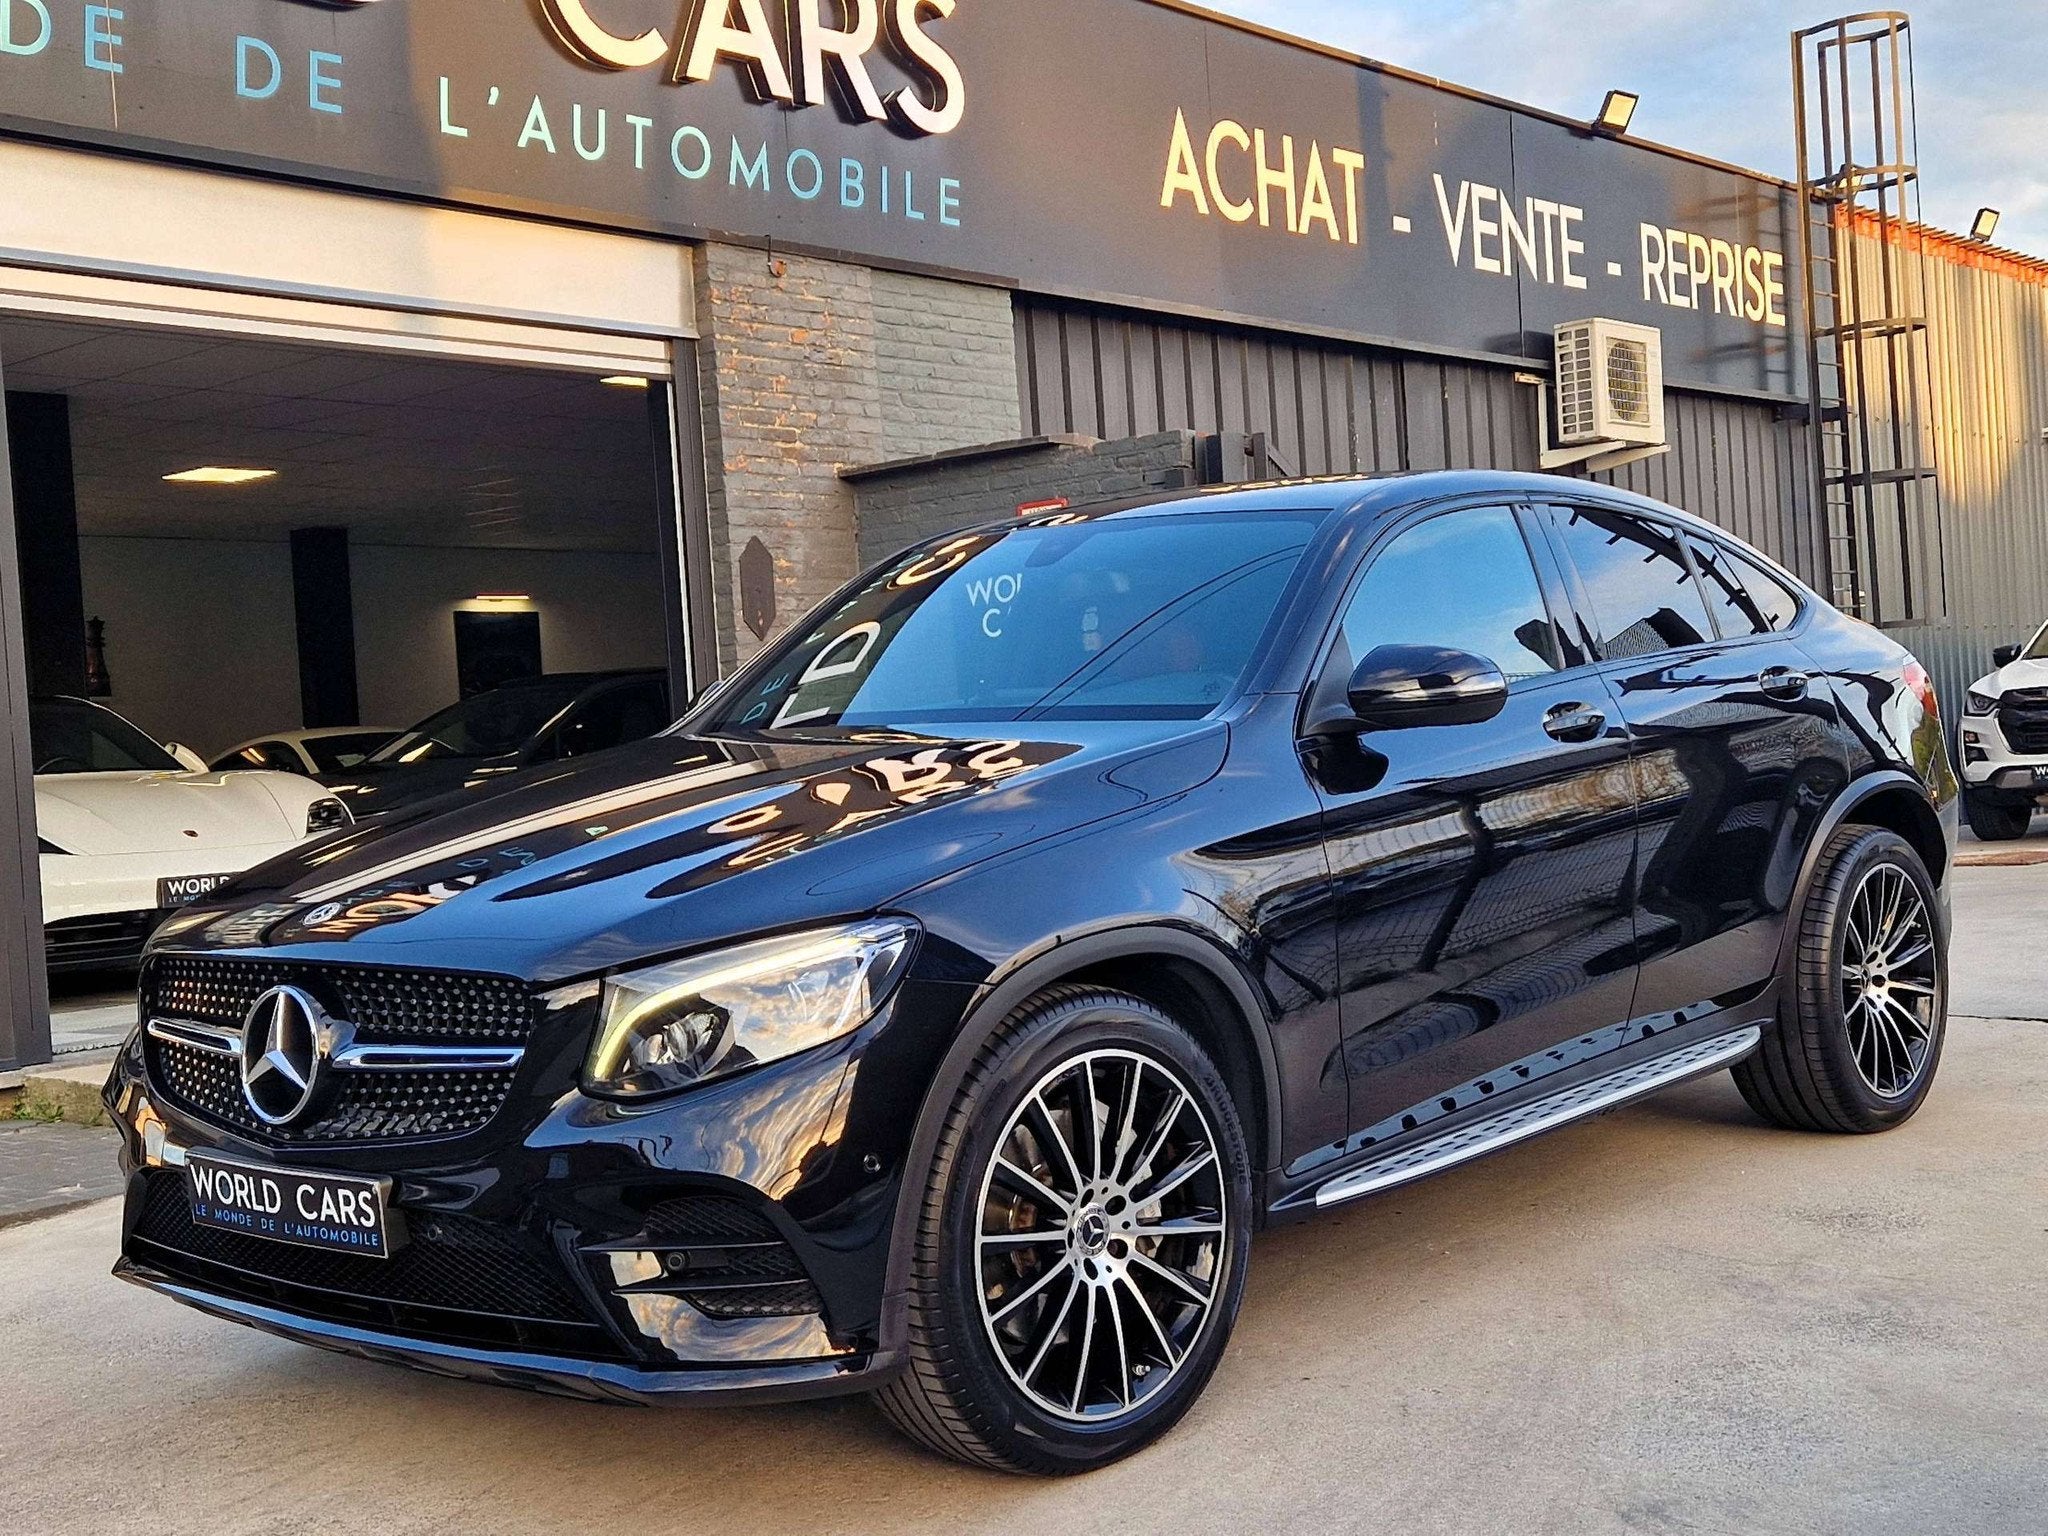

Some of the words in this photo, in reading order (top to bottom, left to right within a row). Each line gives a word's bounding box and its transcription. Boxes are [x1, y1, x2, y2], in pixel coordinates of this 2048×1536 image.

[236, 35, 343, 114] DE
[439, 76, 961, 227] L'AUTOMOBILE
[1159, 105, 1365, 245] ACHAT
[1433, 172, 1587, 290] VENTE
[1639, 222, 1786, 327] REPRISE
[190, 1163, 282, 1214] WORLD
[296, 1184, 376, 1228] CARS
[195, 1203, 207, 1217] LE
[214, 1208, 253, 1228] MONDE
[261, 1217, 276, 1232] DE
[284, 1222, 379, 1247] L'AUTOMOBILE
